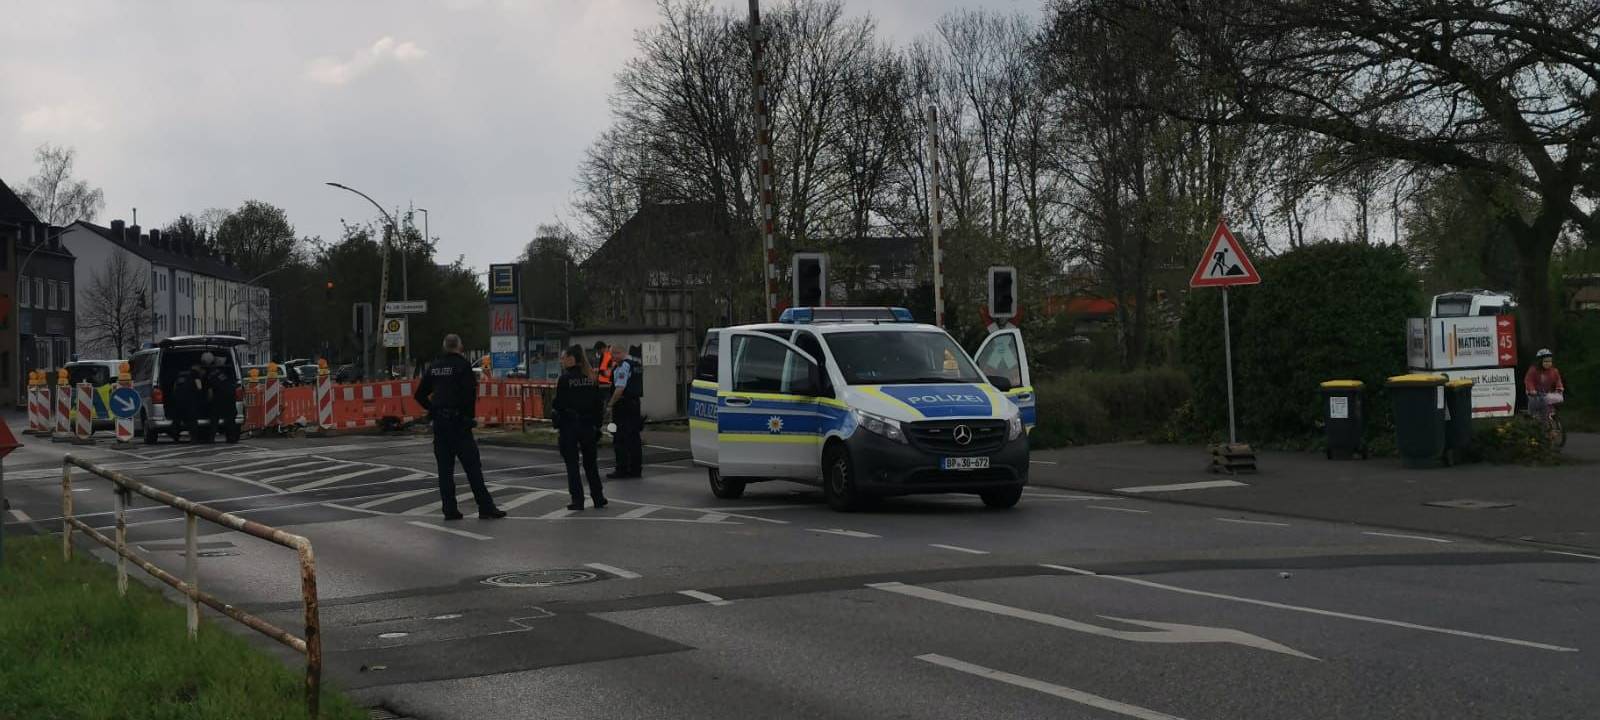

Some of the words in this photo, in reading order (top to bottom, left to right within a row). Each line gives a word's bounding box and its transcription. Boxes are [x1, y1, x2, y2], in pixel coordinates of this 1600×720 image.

[1458, 337, 1490, 349] MATTHIES
[1500, 334, 1512, 349] 45
[1482, 374, 1511, 384] Kublank
[907, 394, 984, 404] POLIZEI
[947, 458, 956, 467] BP
